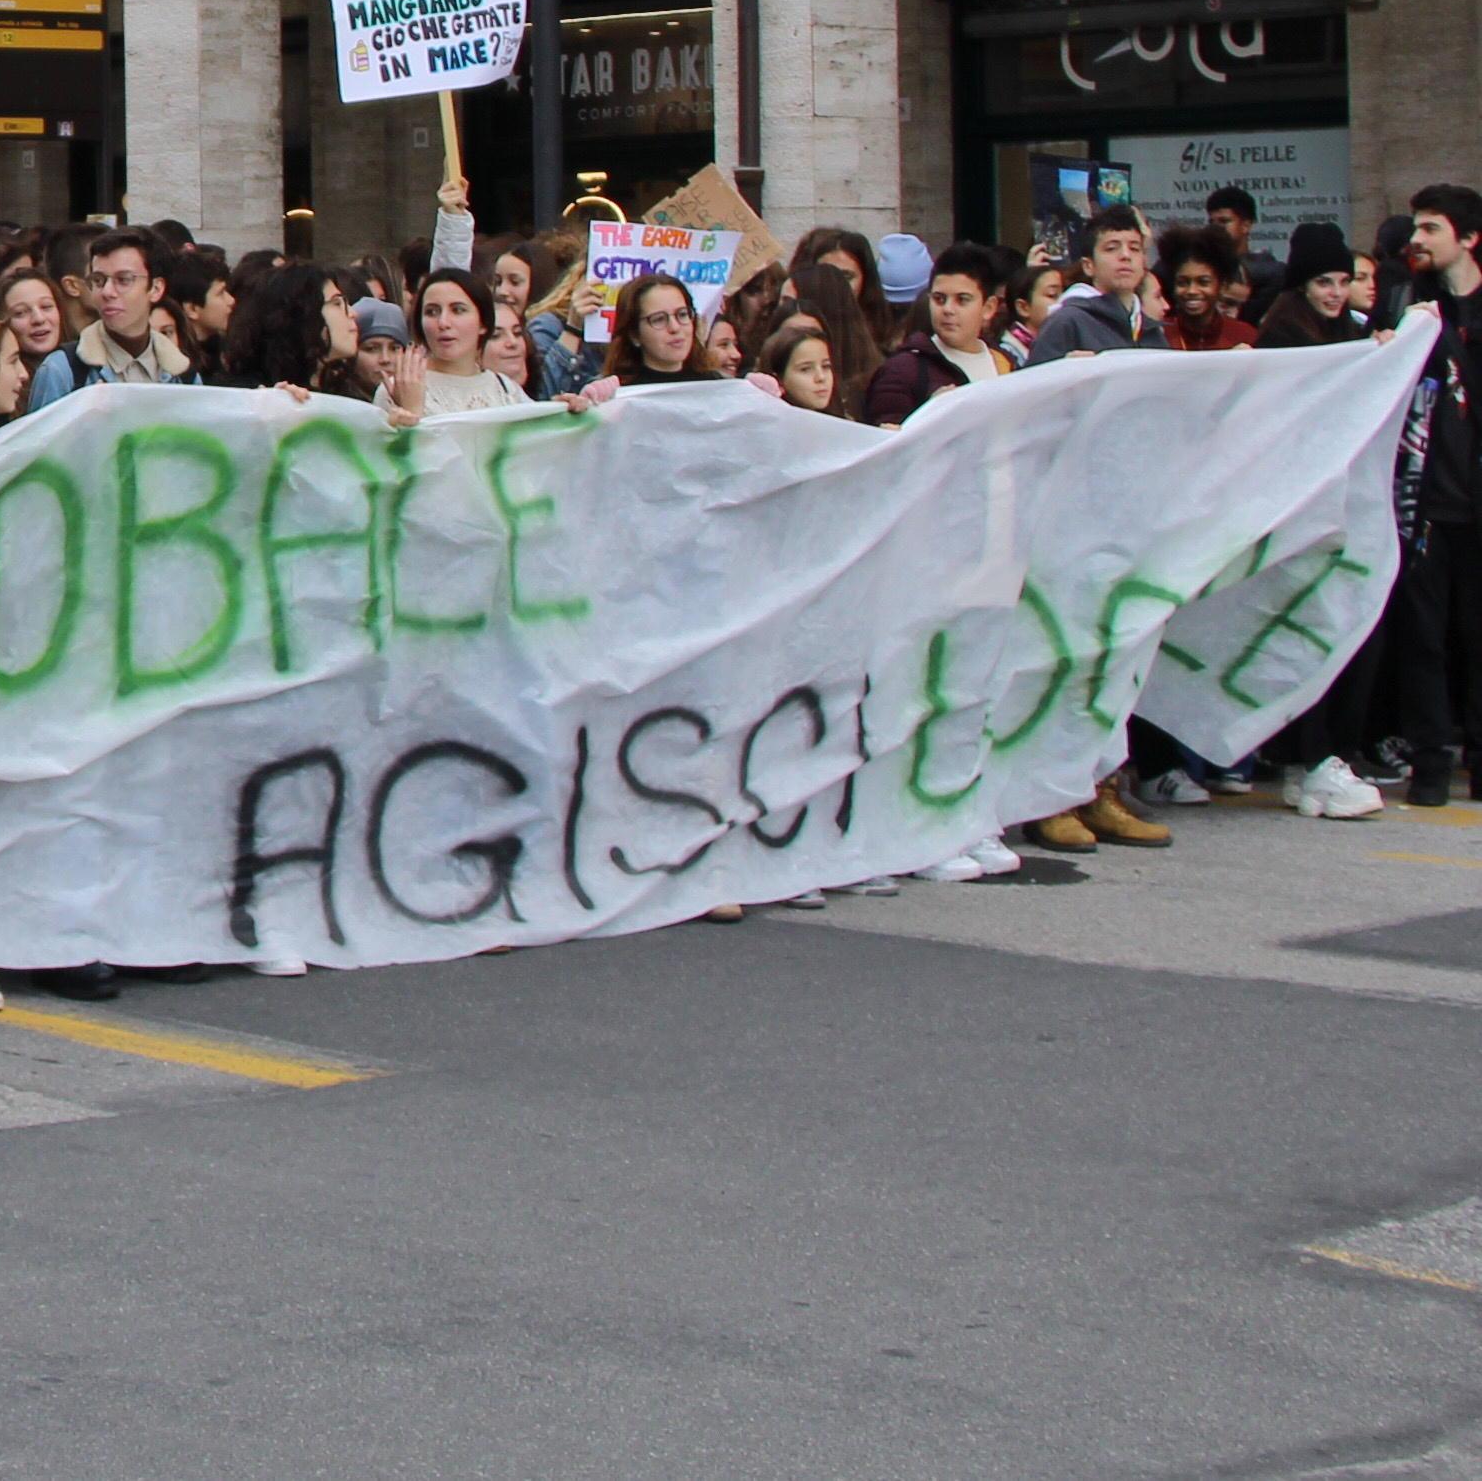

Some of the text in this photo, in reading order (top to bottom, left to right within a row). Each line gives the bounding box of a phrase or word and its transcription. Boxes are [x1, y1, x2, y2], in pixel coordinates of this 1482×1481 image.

[408, 15, 450, 42] CHE
[452, 1, 521, 36] GETTATE
[560, 51, 614, 98] TAR
[578, 104, 656, 120] COMFORT
[1240, 144, 1298, 163] PELLE
[593, 224, 634, 247] THE
[641, 225, 693, 250] EARTH
[228, 670, 872, 949] AGISCI
